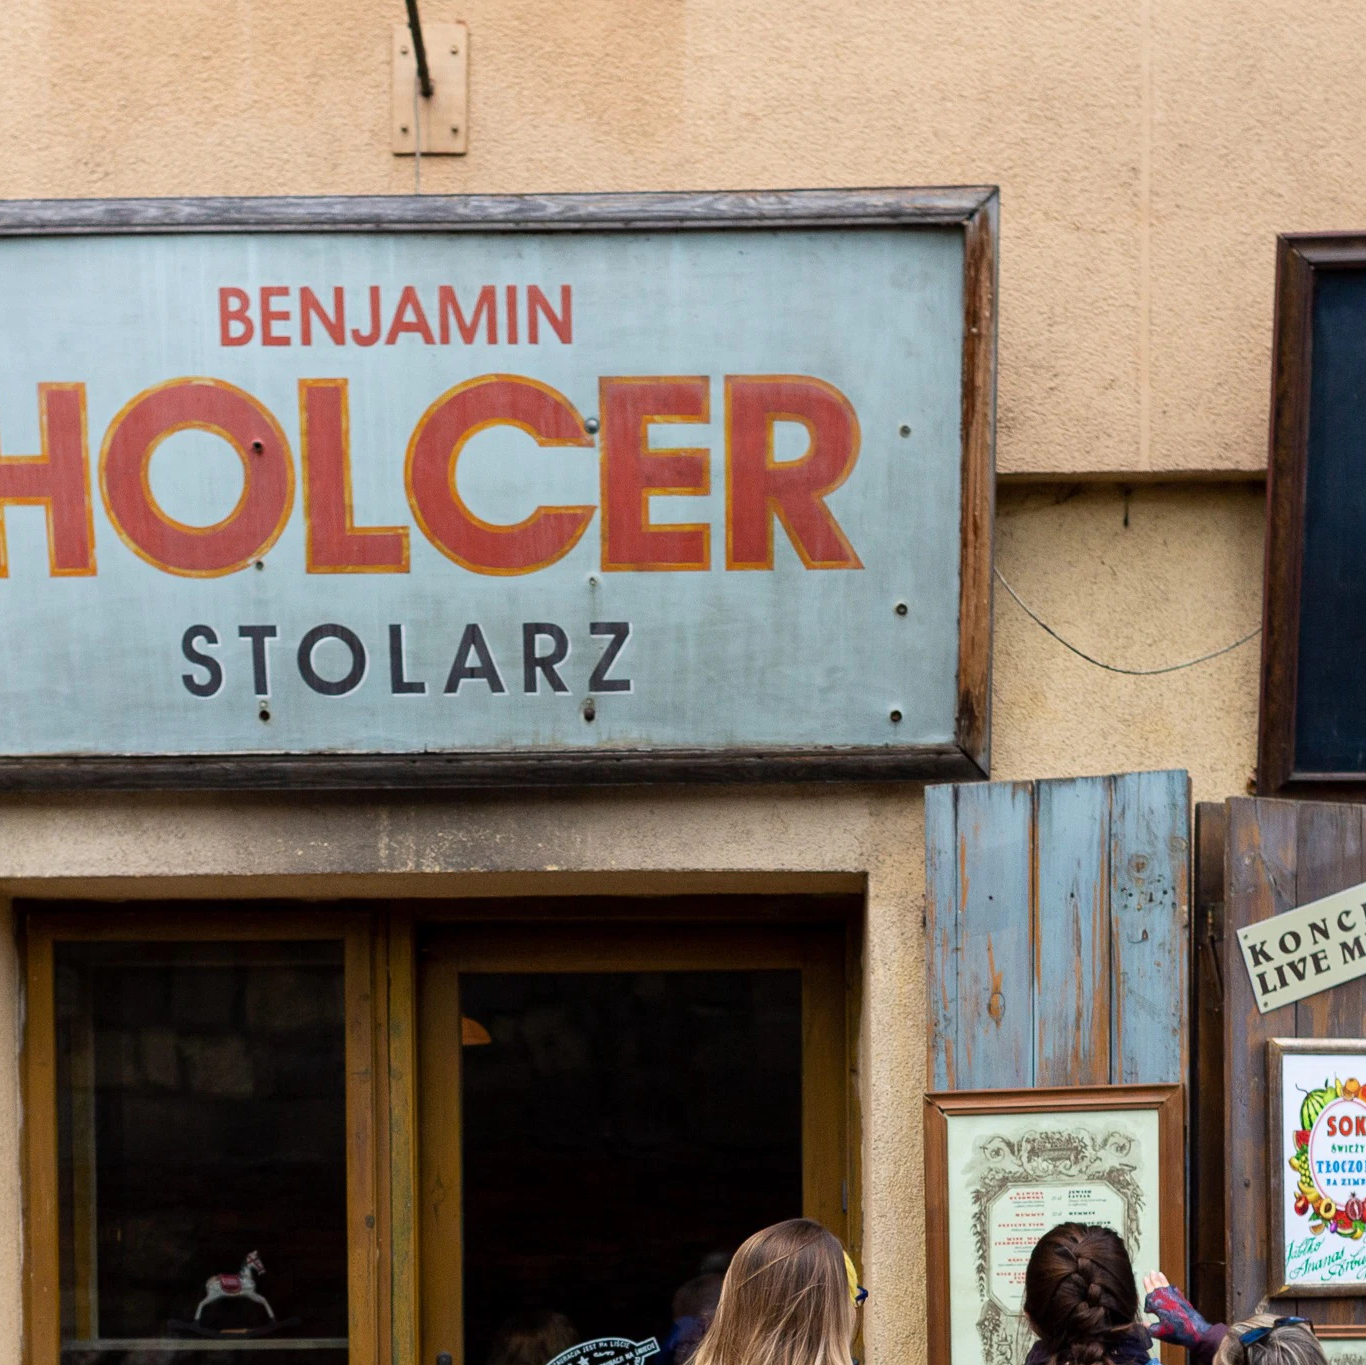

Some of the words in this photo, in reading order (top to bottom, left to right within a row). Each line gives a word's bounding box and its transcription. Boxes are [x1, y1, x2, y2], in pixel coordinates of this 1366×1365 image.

[217, 283, 575, 349] BENJAMIN
[181, 621, 634, 697] STOLARZ
[1256, 949, 1331, 996] LIVE
[1327, 1115, 1366, 1136] SOK
[1326, 1178, 1337, 1186] NA
